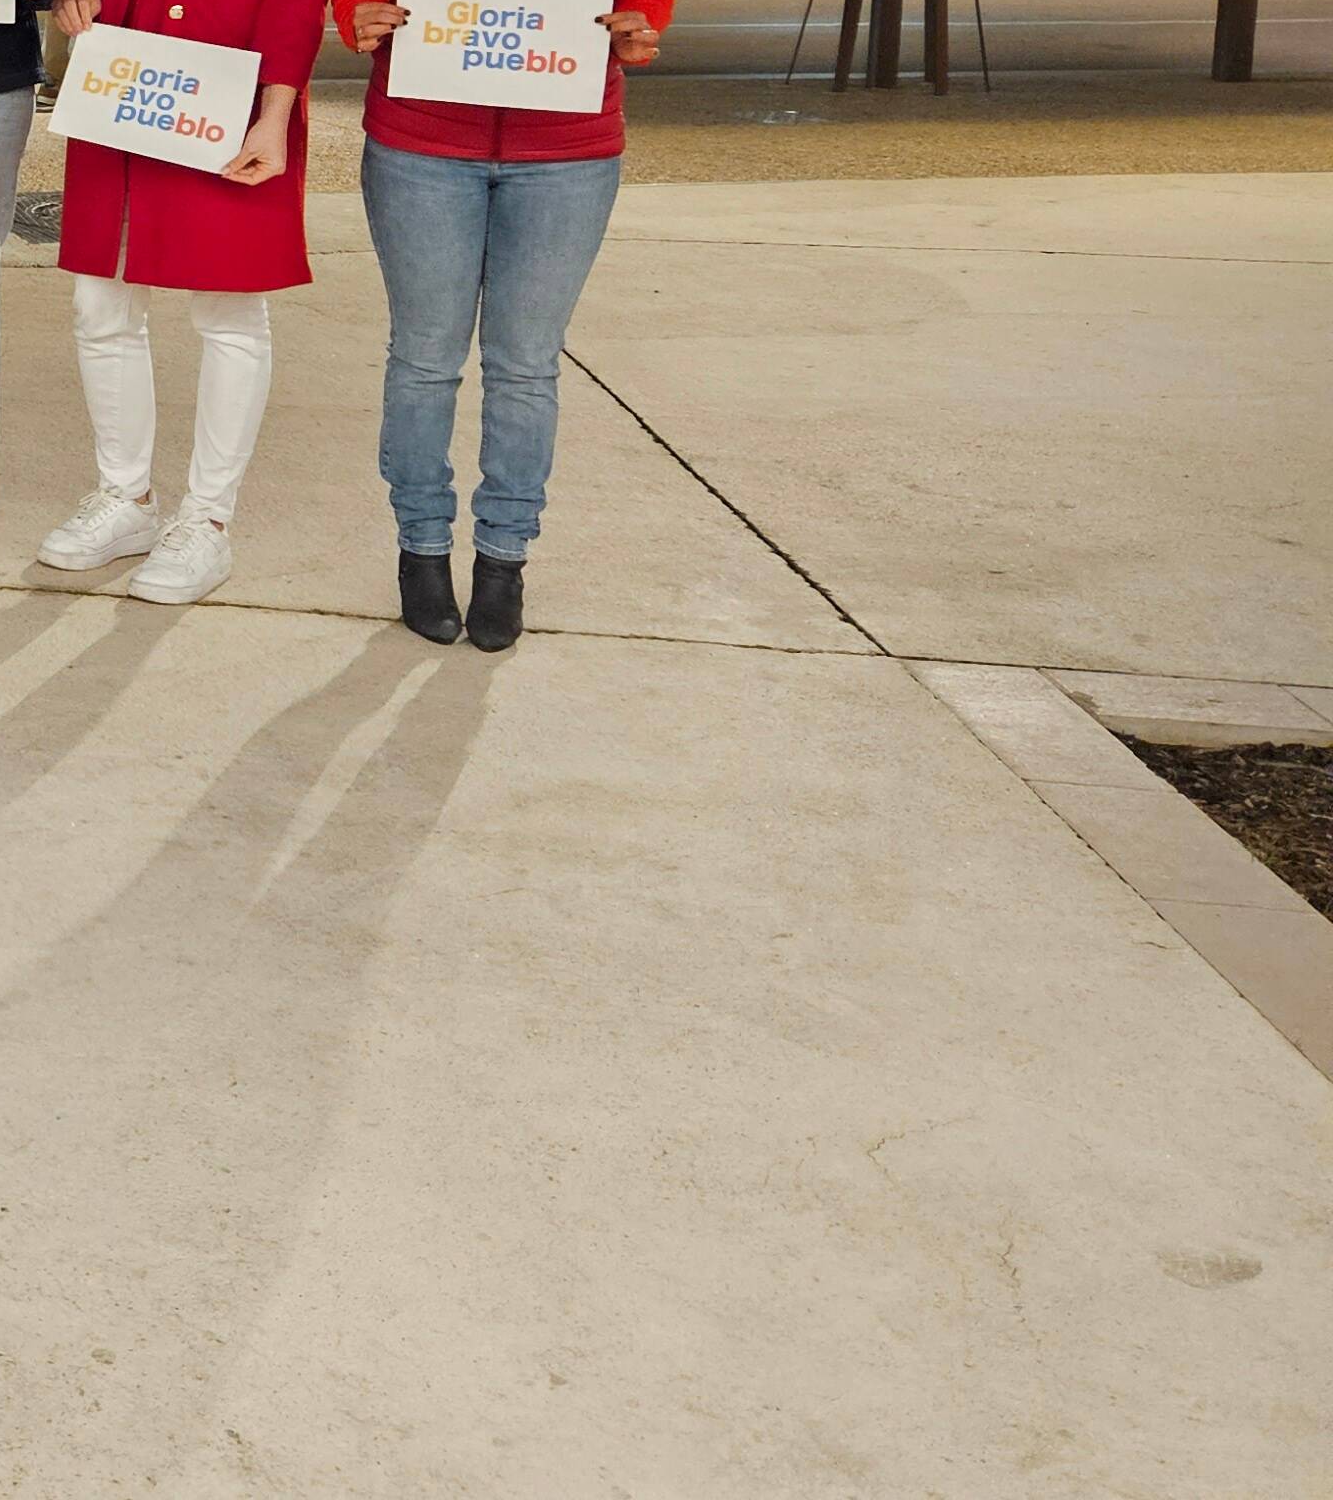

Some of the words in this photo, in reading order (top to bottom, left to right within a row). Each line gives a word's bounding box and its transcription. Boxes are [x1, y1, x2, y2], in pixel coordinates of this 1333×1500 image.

[447, 1, 544, 31] Gloria
[423, 20, 521, 50] bravo
[109, 58, 200, 96] Gloria
[462, 49, 578, 76] pueblo
[83, 71, 175, 111] bravo
[114, 103, 225, 144] pueblo
